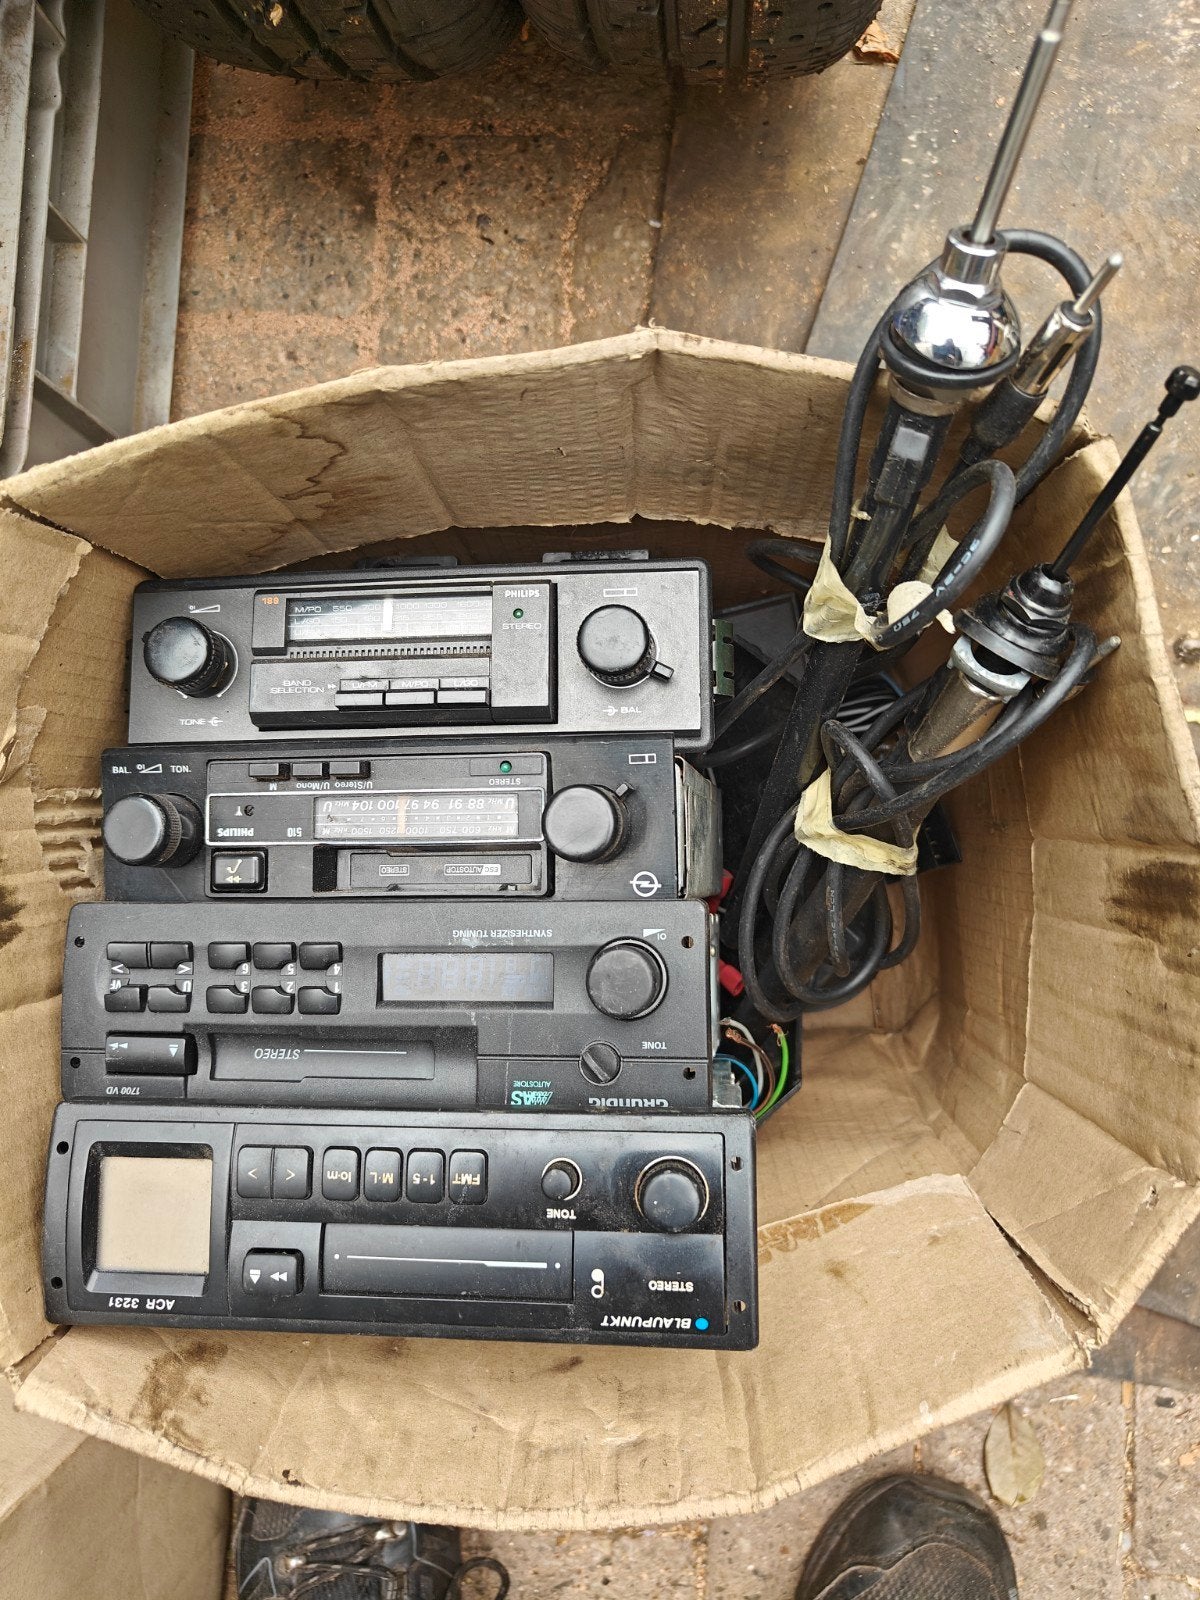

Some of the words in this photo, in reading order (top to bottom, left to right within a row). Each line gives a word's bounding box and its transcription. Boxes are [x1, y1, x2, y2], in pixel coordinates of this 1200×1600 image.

[505, 590, 540, 598] PHILIPS
[502, 622, 542, 630] STEREO
[401, 680, 429, 688] M/PO
[453, 679, 478, 687] L/GO
[620, 706, 642, 714] BAL
[180, 718, 206, 726] TONE
[112, 766, 132, 774] BAL.
[170, 765, 192, 773] TON.
[296, 782, 330, 790] U/Mono
[334, 781, 373, 790] U/Stereo
[488, 778, 521, 786] STEREO
[322, 801, 333, 812] U
[352, 800, 373, 811] 104
[377, 799, 399, 811] 100
[404, 799, 419, 810] 97
[423, 799, 439, 810] 94
[448, 799, 463, 810] 91
[467, 799, 485, 810] 88
[216, 827, 254, 837] PHILIPS
[287, 827, 302, 838] 510
[351, 827, 372, 835] 1500
[379, 827, 400, 835] 1250
[406, 826, 429, 835] 1000
[440, 826, 457, 834] 750
[462, 826, 481, 834] 600
[381, 866, 408, 874] STEREO
[446, 866, 483, 874] AUTOSTOP
[452, 929, 489, 938] TUNING
[490, 929, 553, 938] SYNTHESIZER
[241, 963, 249, 974] 6
[287, 963, 295, 975] 5
[333, 963, 341, 975] 4
[109, 979, 122, 990] VF
[182, 980, 192, 993] U
[240, 980, 249, 993] 3
[286, 981, 294, 993] 2
[334, 981, 340, 994] 1
[641, 1041, 667, 1050] TONE
[254, 1048, 301, 1059] STEREO
[513, 1080, 552, 1088] AUTOSTORE
[106, 1086, 119, 1095] VD
[121, 1086, 141, 1095] 1700
[588, 1097, 669, 1107] GRUNDIG
[546, 1208, 577, 1220] TONE
[648, 1280, 694, 1292] STEREO
[108, 1296, 140, 1308] 3231
[145, 1298, 175, 1311] ACR
[600, 1315, 692, 1329] BLAUPUNKT
